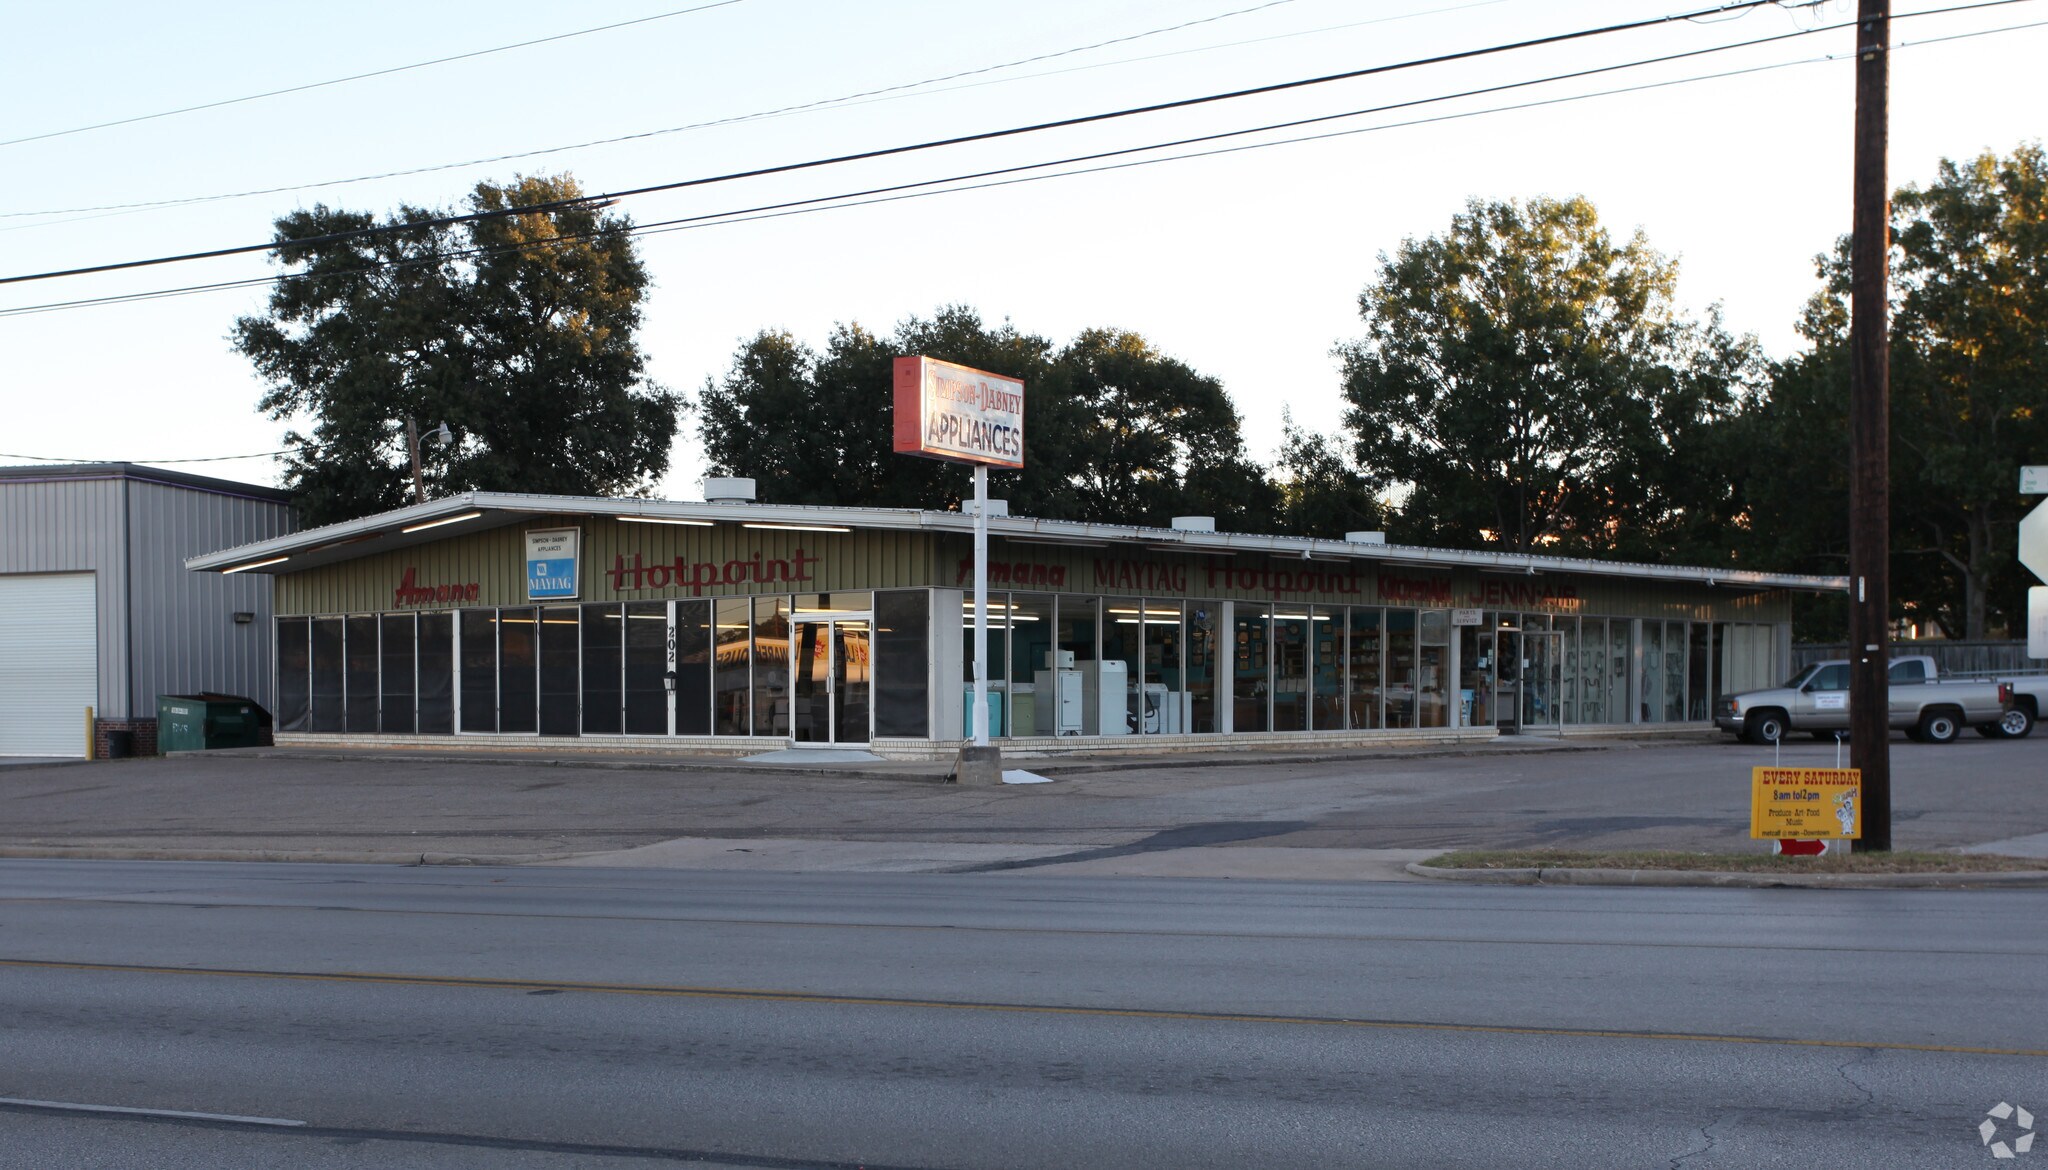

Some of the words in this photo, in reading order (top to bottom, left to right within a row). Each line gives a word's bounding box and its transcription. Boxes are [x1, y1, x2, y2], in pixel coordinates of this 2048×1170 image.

[928, 411, 1020, 457] APPLIANCES
[394, 566, 479, 609] Amana
[529, 577, 572, 590] MAYTAG
[602, 548, 823, 597] Hotpoint
[1093, 558, 1187, 592] MAYTAG
[1202, 554, 1364, 600] Hotpoint
[668, 626, 676, 663] 202
[1763, 771, 1801, 785] EVERY
[1804, 771, 1860, 786] SATURDAY
